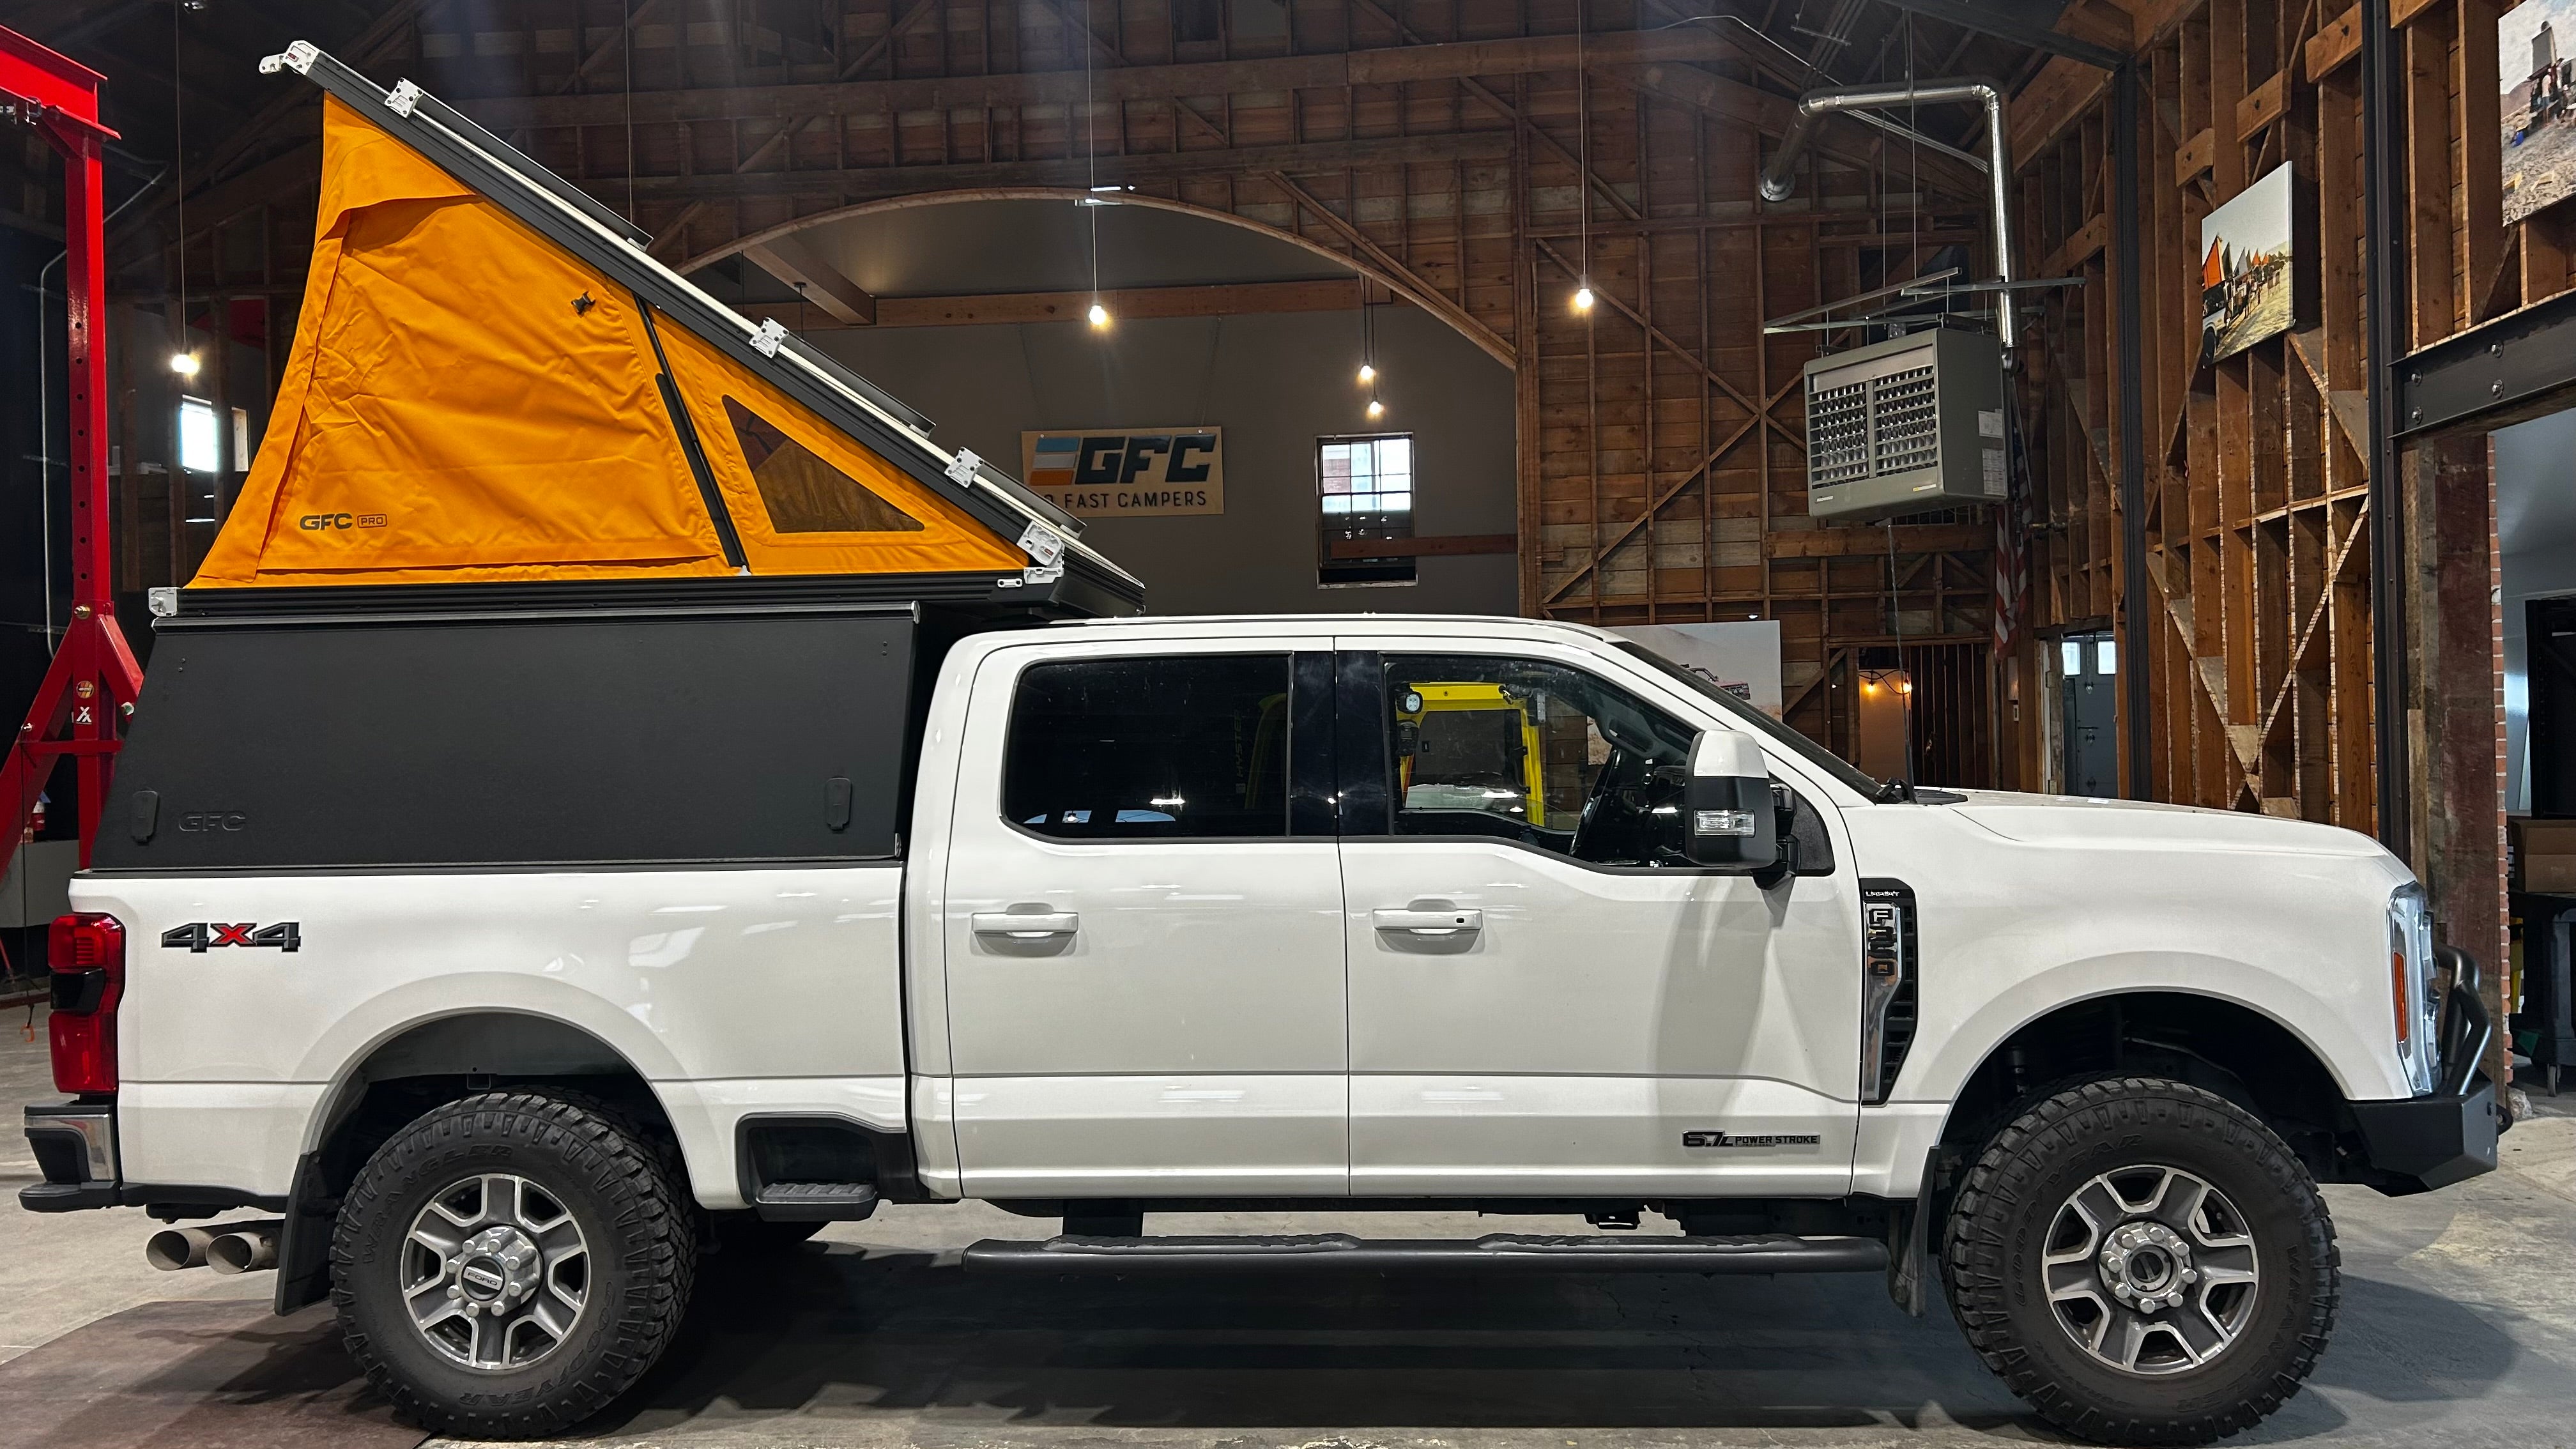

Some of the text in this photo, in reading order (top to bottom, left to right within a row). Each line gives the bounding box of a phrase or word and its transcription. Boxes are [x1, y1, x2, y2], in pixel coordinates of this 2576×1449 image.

[1075, 434, 1216, 485] GFC
[1064, 493, 1110, 509] FAST
[1117, 491, 1207, 507] CAMPERS
[300, 513, 383, 530] GFC PRO
[178, 811, 246, 832] GFC
[1682, 1131, 1733, 1147] 6.7L
[1735, 1135, 1772, 1144] POWER
[1775, 1135, 1818, 1144] STROKE
[467, 1271, 498, 1286] FORD
